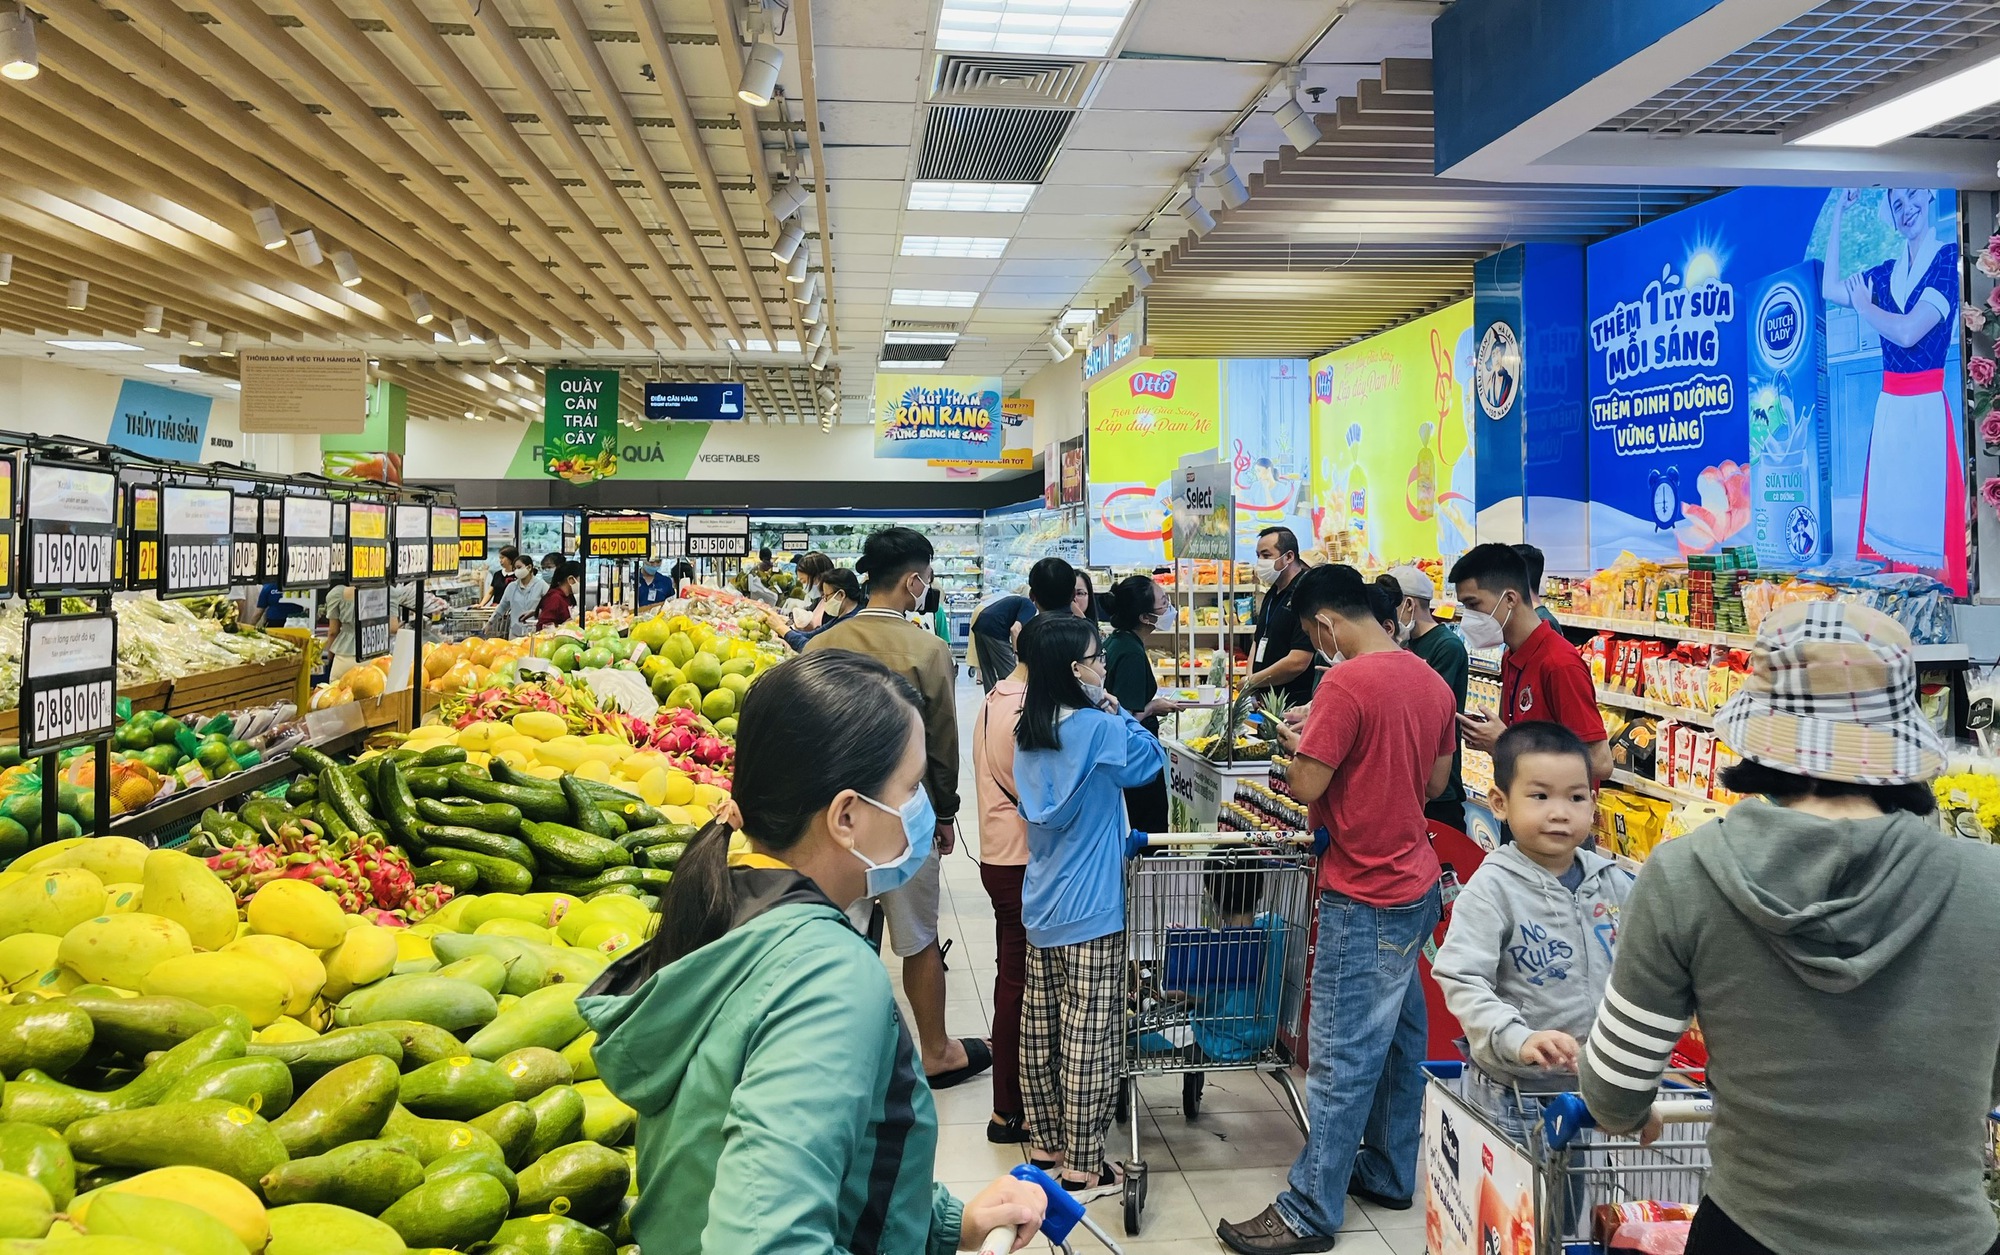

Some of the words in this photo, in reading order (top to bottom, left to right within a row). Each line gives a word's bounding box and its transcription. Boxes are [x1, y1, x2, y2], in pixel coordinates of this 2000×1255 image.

[1593, 307, 1641, 346] THÊM
[1646, 286, 1658, 325] 1
[1665, 294, 1685, 321] LY
[1691, 284, 1730, 318] SỮA
[1768, 314, 1793, 331] DUTCH
[1770, 327, 1791, 342] LADY
[1609, 331, 1647, 380] MỖI
[1655, 324, 1716, 364] SÁNG
[560, 377, 603, 394] QUẦY
[1134, 374, 1171, 393] Otto
[1317, 372, 1330, 397] Otto
[565, 395, 597, 411] CÂN
[1594, 397, 1630, 422] THÊM
[1634, 393, 1669, 417] DINH
[1674, 382, 1729, 411] DƯỠNG
[125, 410, 155, 438] THỦY
[158, 414, 176, 441] HẢI
[177, 417, 198, 444] SẢN
[563, 412, 598, 428] TRÁI
[896, 401, 935, 429] RỘN
[940, 405, 990, 428] RÀNG
[565, 430, 596, 445] CÂY
[948, 429, 960, 439] HÈ
[1618, 423, 1655, 448] VỮNG
[1658, 416, 1700, 442] VÀNG
[698, 454, 760, 464] VEGETABLES
[1765, 472, 1781, 488] SỮA
[1782, 471, 1802, 488] TƯƠI
[1186, 486, 1212, 510] Select
[592, 540, 636, 552] 64.900
[692, 539, 734, 550] 31.500
[38, 542, 98, 572] 19.900
[170, 550, 218, 578] 31.300
[57, 634, 70, 644] long
[89, 632, 96, 643] kg
[38, 692, 98, 732] 28.800
[1171, 768, 1192, 801] Select
[1520, 920, 1547, 945] NO
[1508, 940, 1573, 972] RULES
